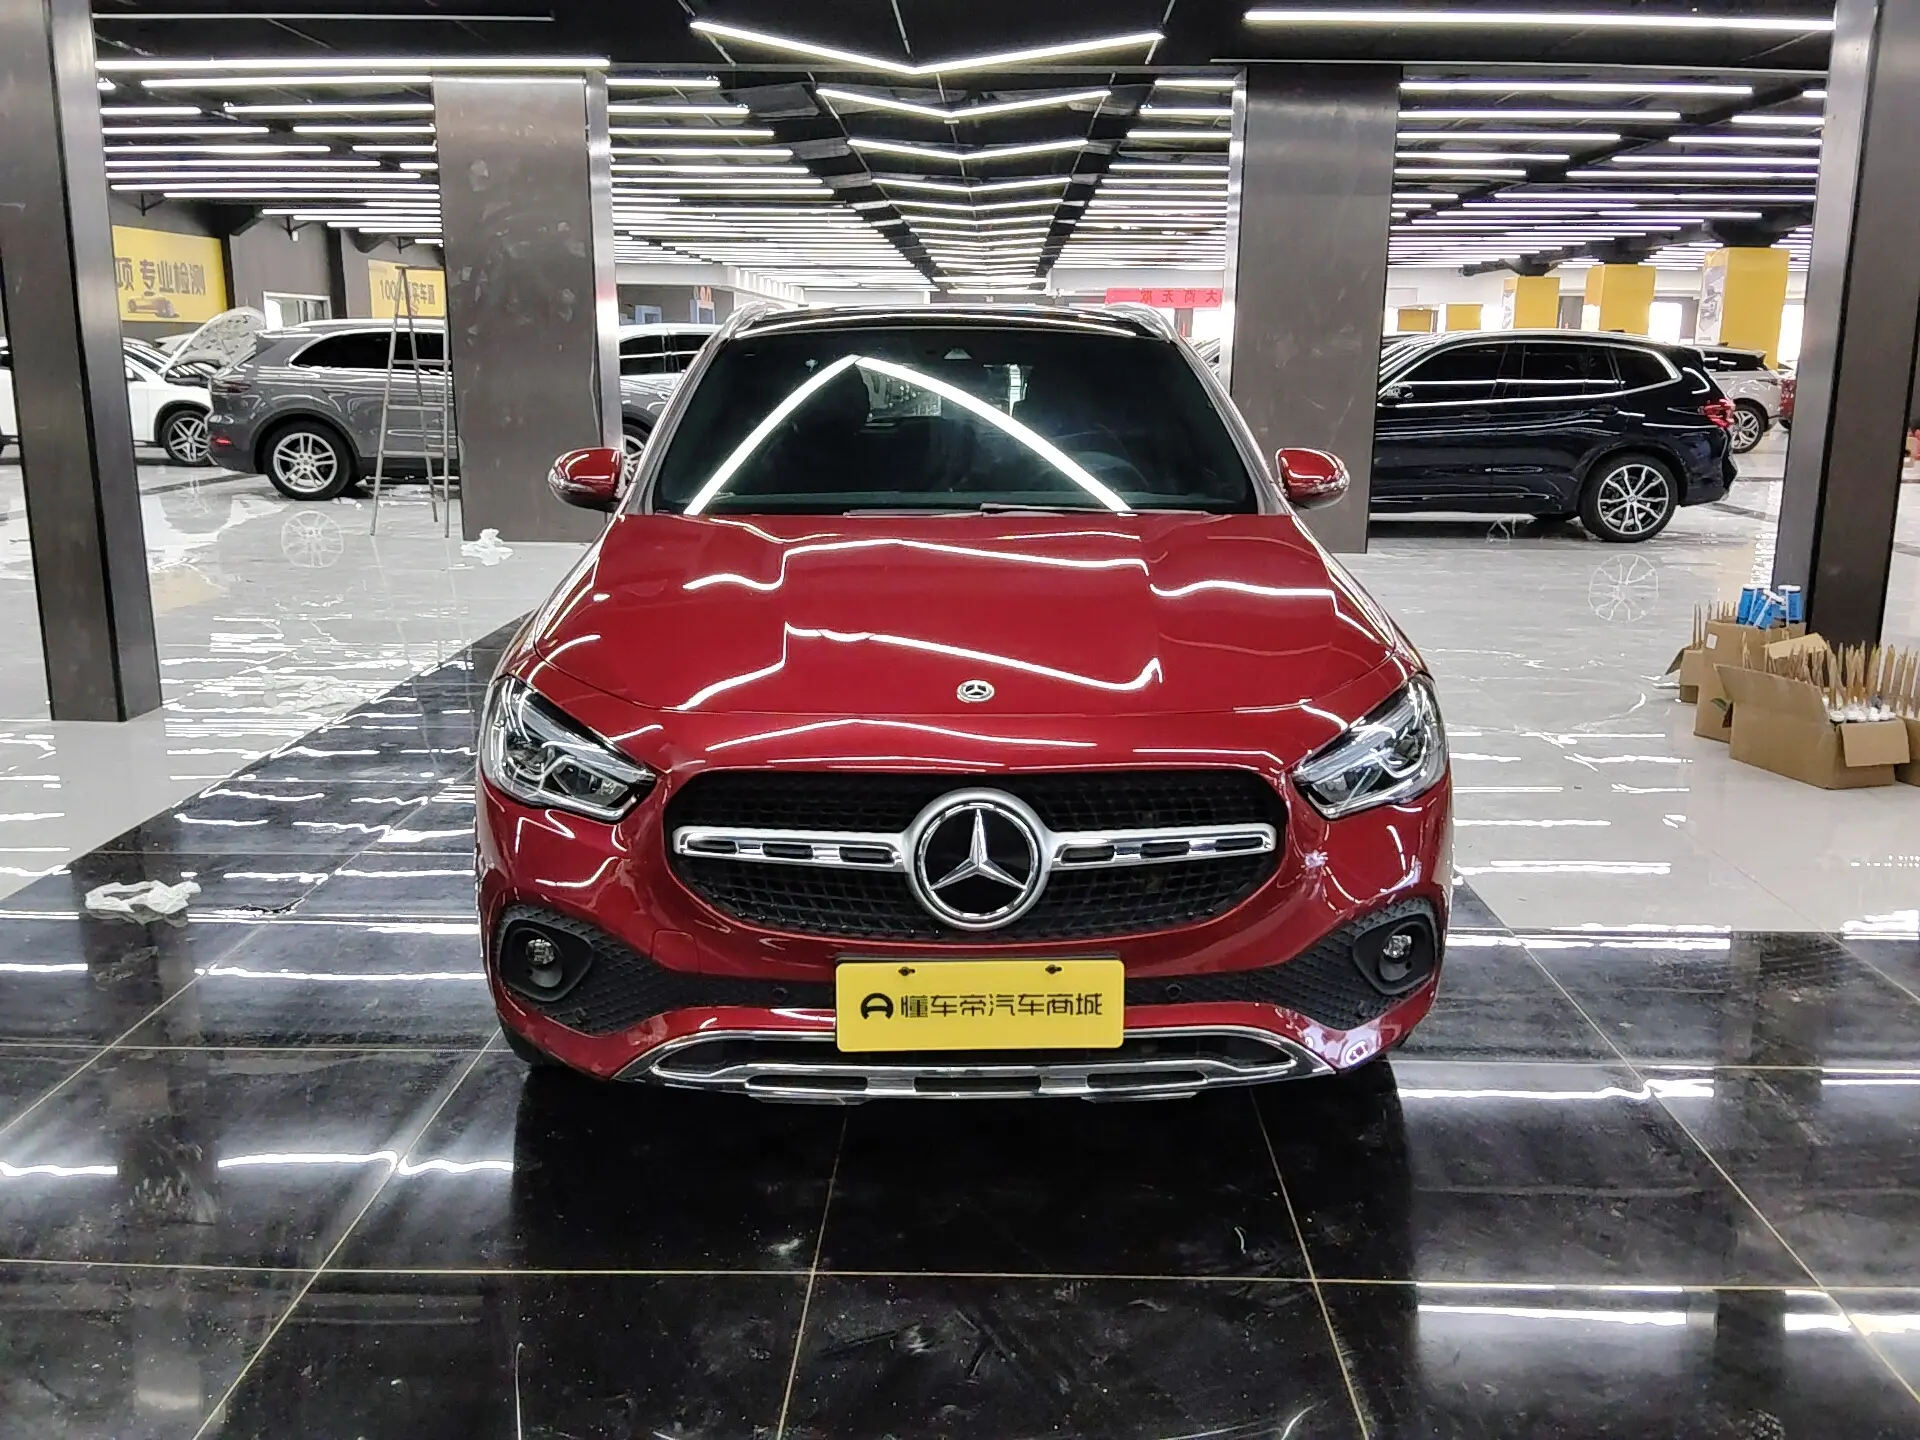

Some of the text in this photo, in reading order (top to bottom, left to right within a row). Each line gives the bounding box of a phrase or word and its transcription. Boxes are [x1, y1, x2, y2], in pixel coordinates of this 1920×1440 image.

[900, 992, 1103, 1018] 懂车帝汽车商城
